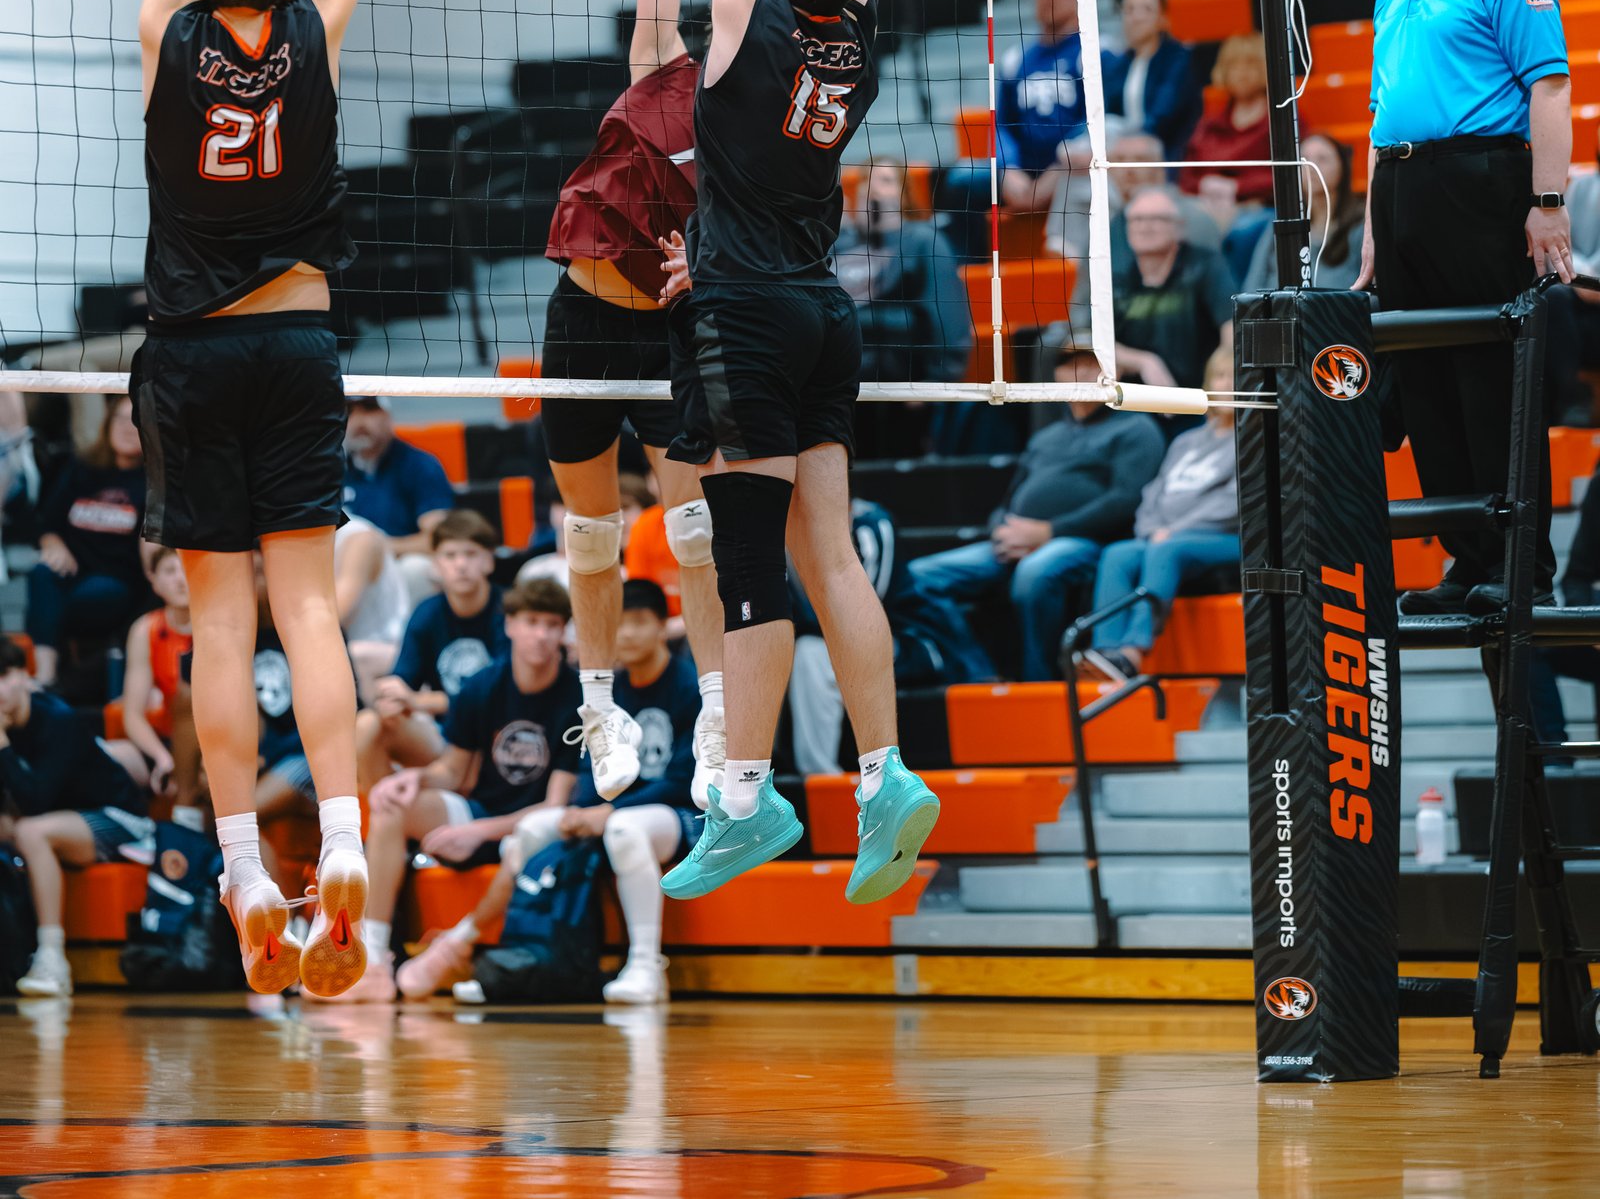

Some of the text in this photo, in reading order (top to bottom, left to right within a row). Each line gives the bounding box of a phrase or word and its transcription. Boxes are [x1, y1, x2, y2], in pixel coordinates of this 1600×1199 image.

[199, 98, 283, 181] 21
[782, 65, 856, 149] 15
[1321, 562, 1373, 845] TIGERS
[1368, 638, 1389, 768] WWSHS
[1271, 758, 1297, 948] sports imports
